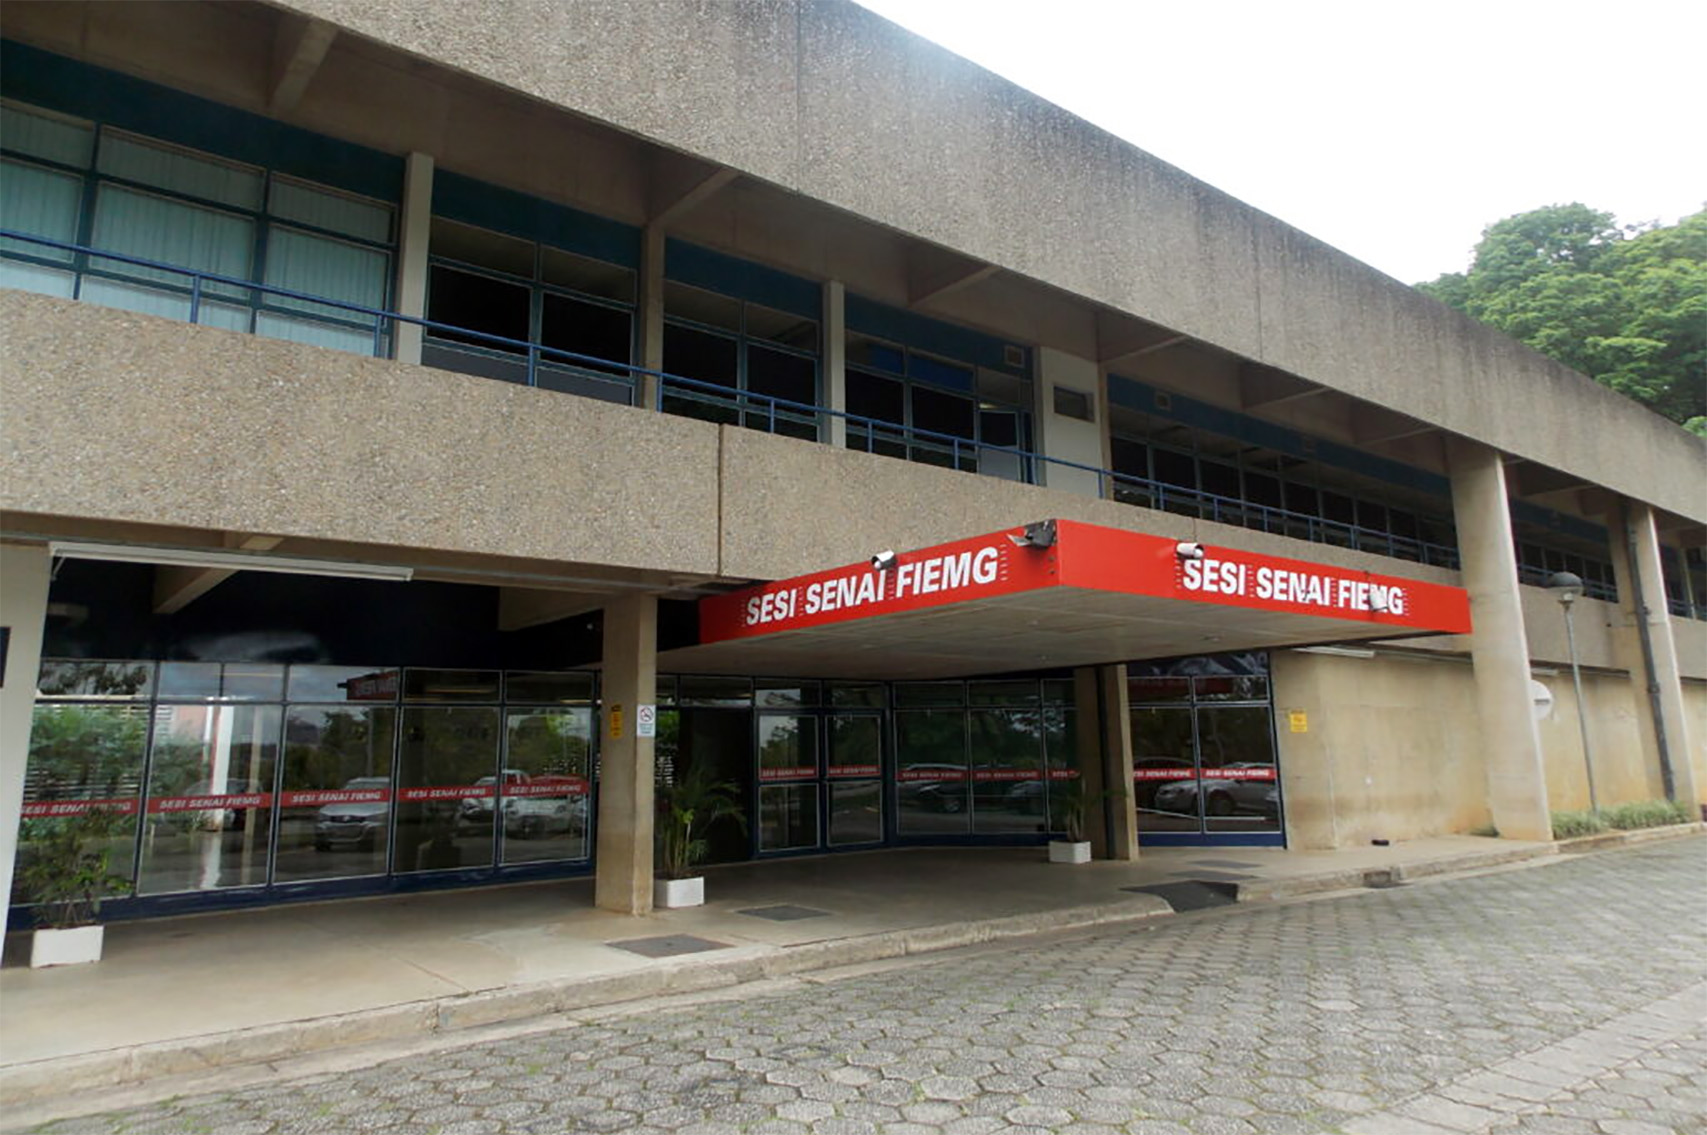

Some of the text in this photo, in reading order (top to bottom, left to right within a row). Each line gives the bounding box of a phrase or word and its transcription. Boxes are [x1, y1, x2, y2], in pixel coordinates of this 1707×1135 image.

[746, 546, 998, 625] SESI SENAI FIEMG
[1183, 559, 1246, 595] SESI
[1256, 567, 1331, 606] SENAI
